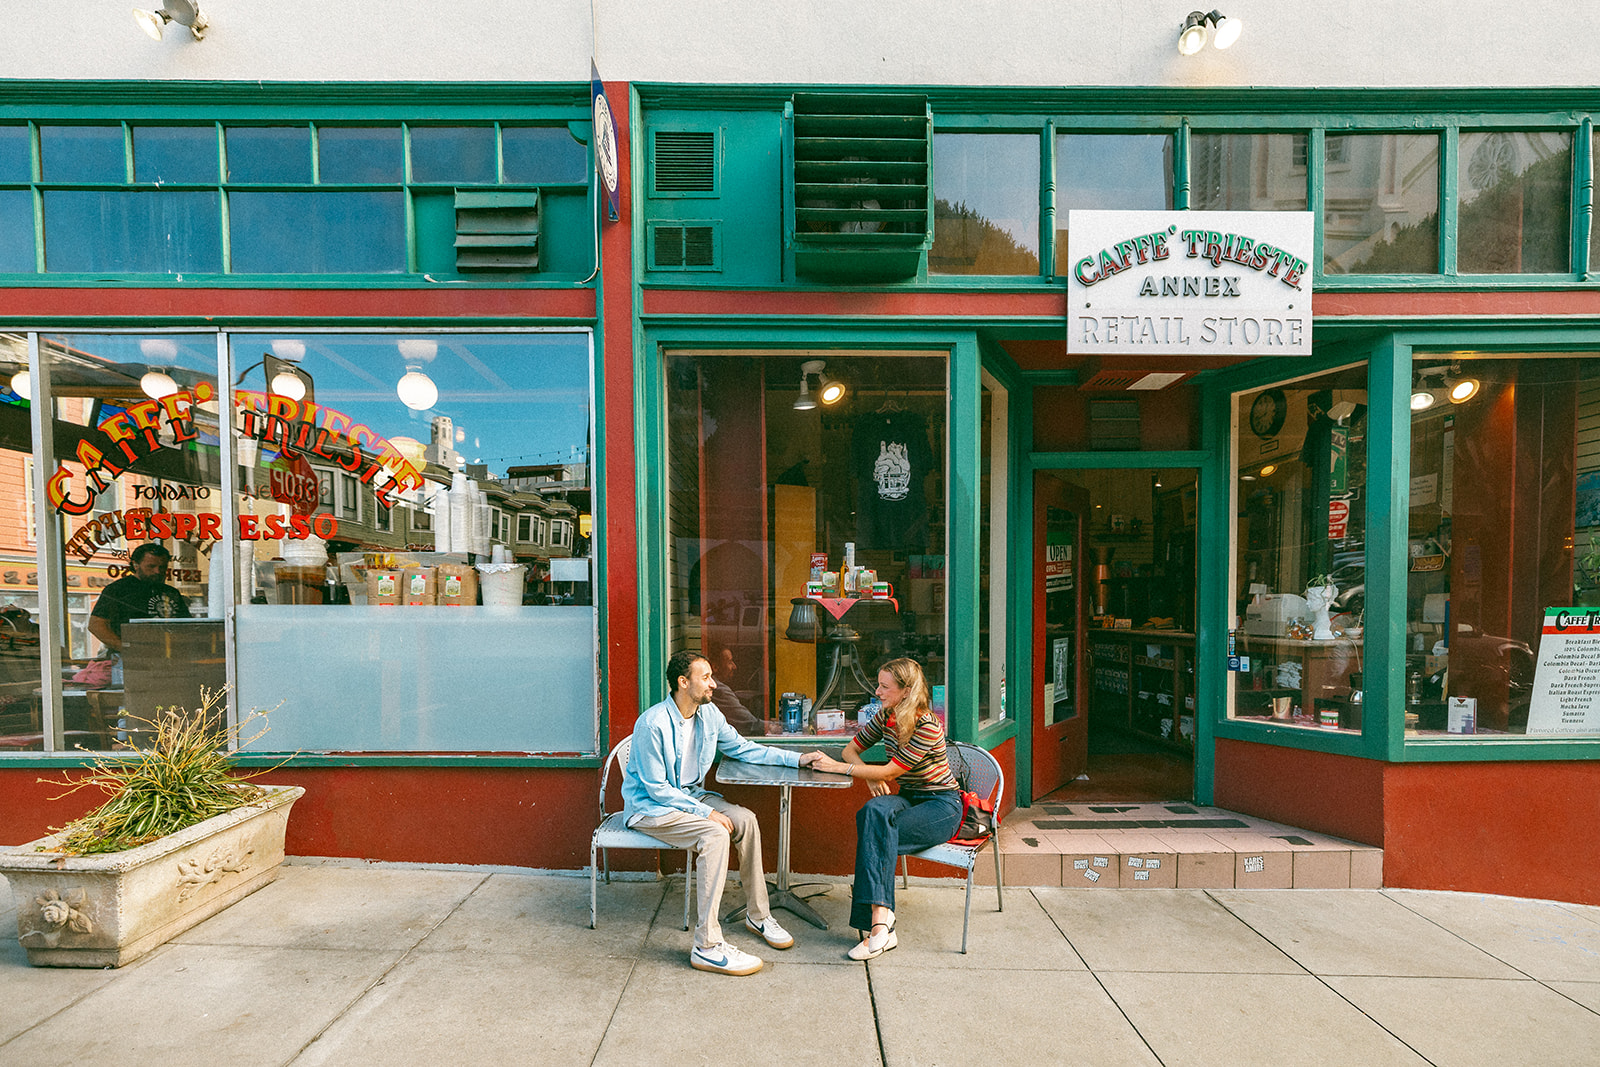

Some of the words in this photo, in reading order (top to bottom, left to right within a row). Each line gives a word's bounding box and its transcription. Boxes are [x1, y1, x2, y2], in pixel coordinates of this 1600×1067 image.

[1182, 230, 1309, 289] TRIESTE
[1139, 275, 1242, 296] ANNEX
[1078, 316, 1190, 346] RETAIL
[1199, 316, 1303, 346] STORE
[234, 389, 426, 511] TRIESTE
[132, 483, 211, 501] FONDATO
[1049, 542, 1068, 561] OPEN
[1555, 610, 1587, 632] CAFFE
